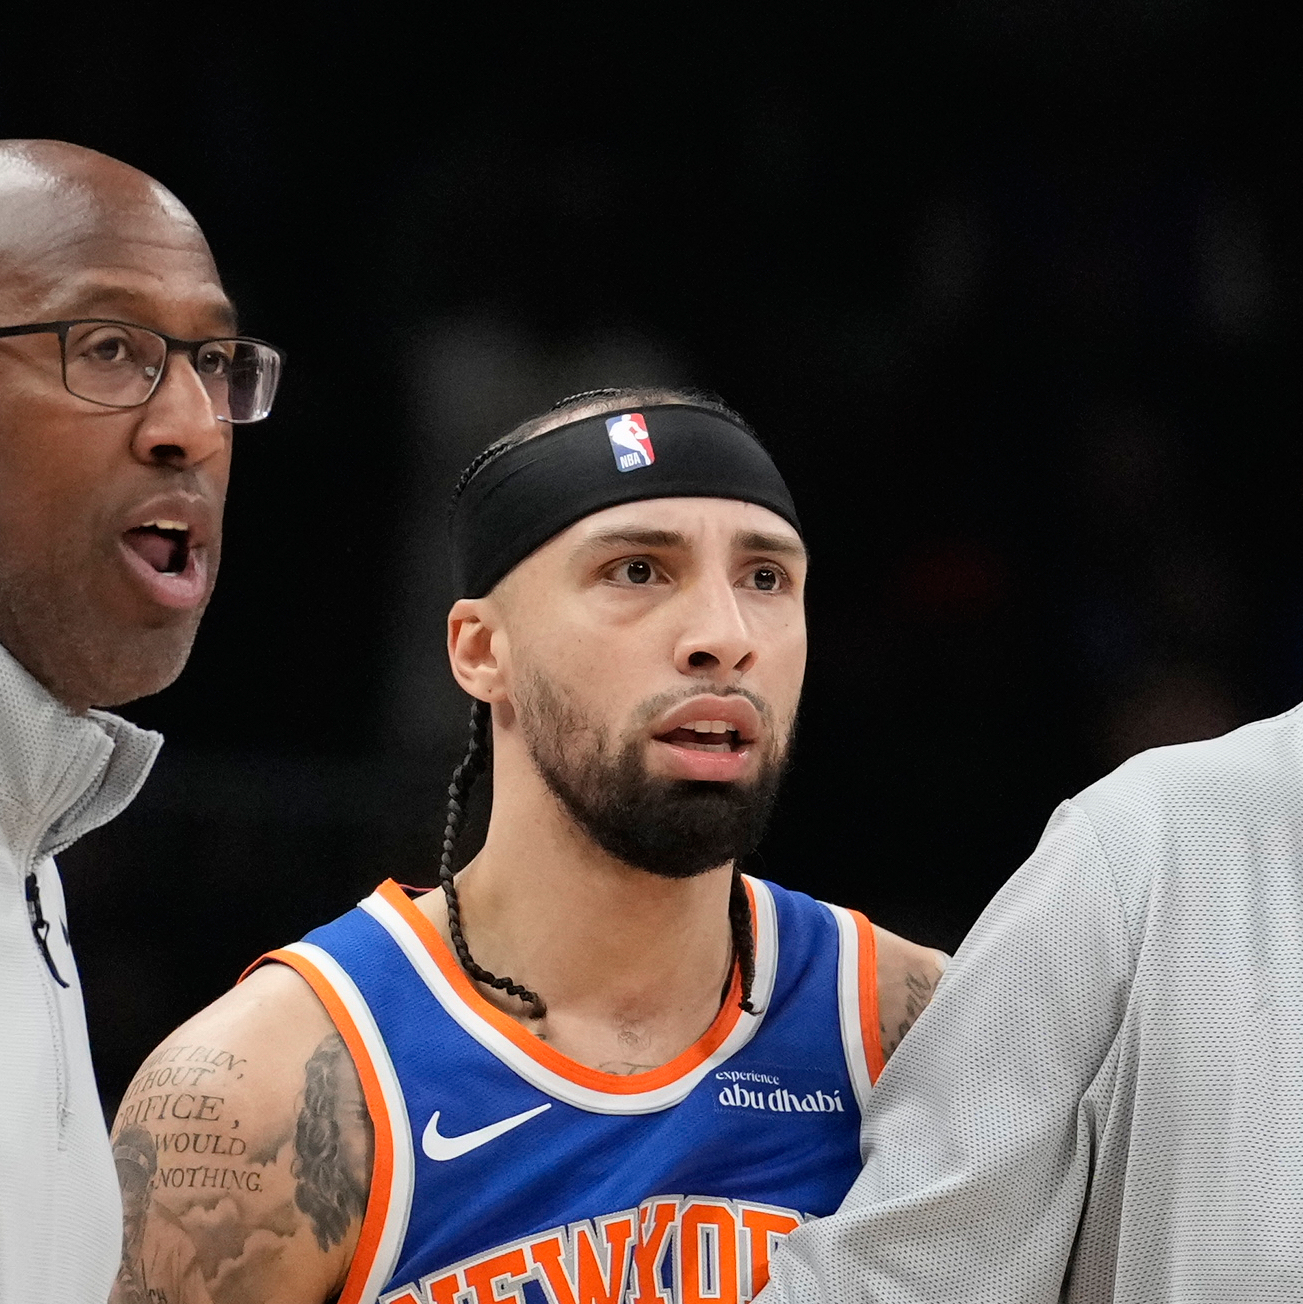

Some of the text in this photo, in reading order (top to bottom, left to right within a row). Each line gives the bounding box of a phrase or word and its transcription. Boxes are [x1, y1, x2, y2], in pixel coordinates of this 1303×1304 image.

[620, 452, 641, 469] NBA
[715, 1070, 780, 1085] experience
[718, 1083, 766, 1110] abu
[155, 1132, 246, 1156] WOULD
